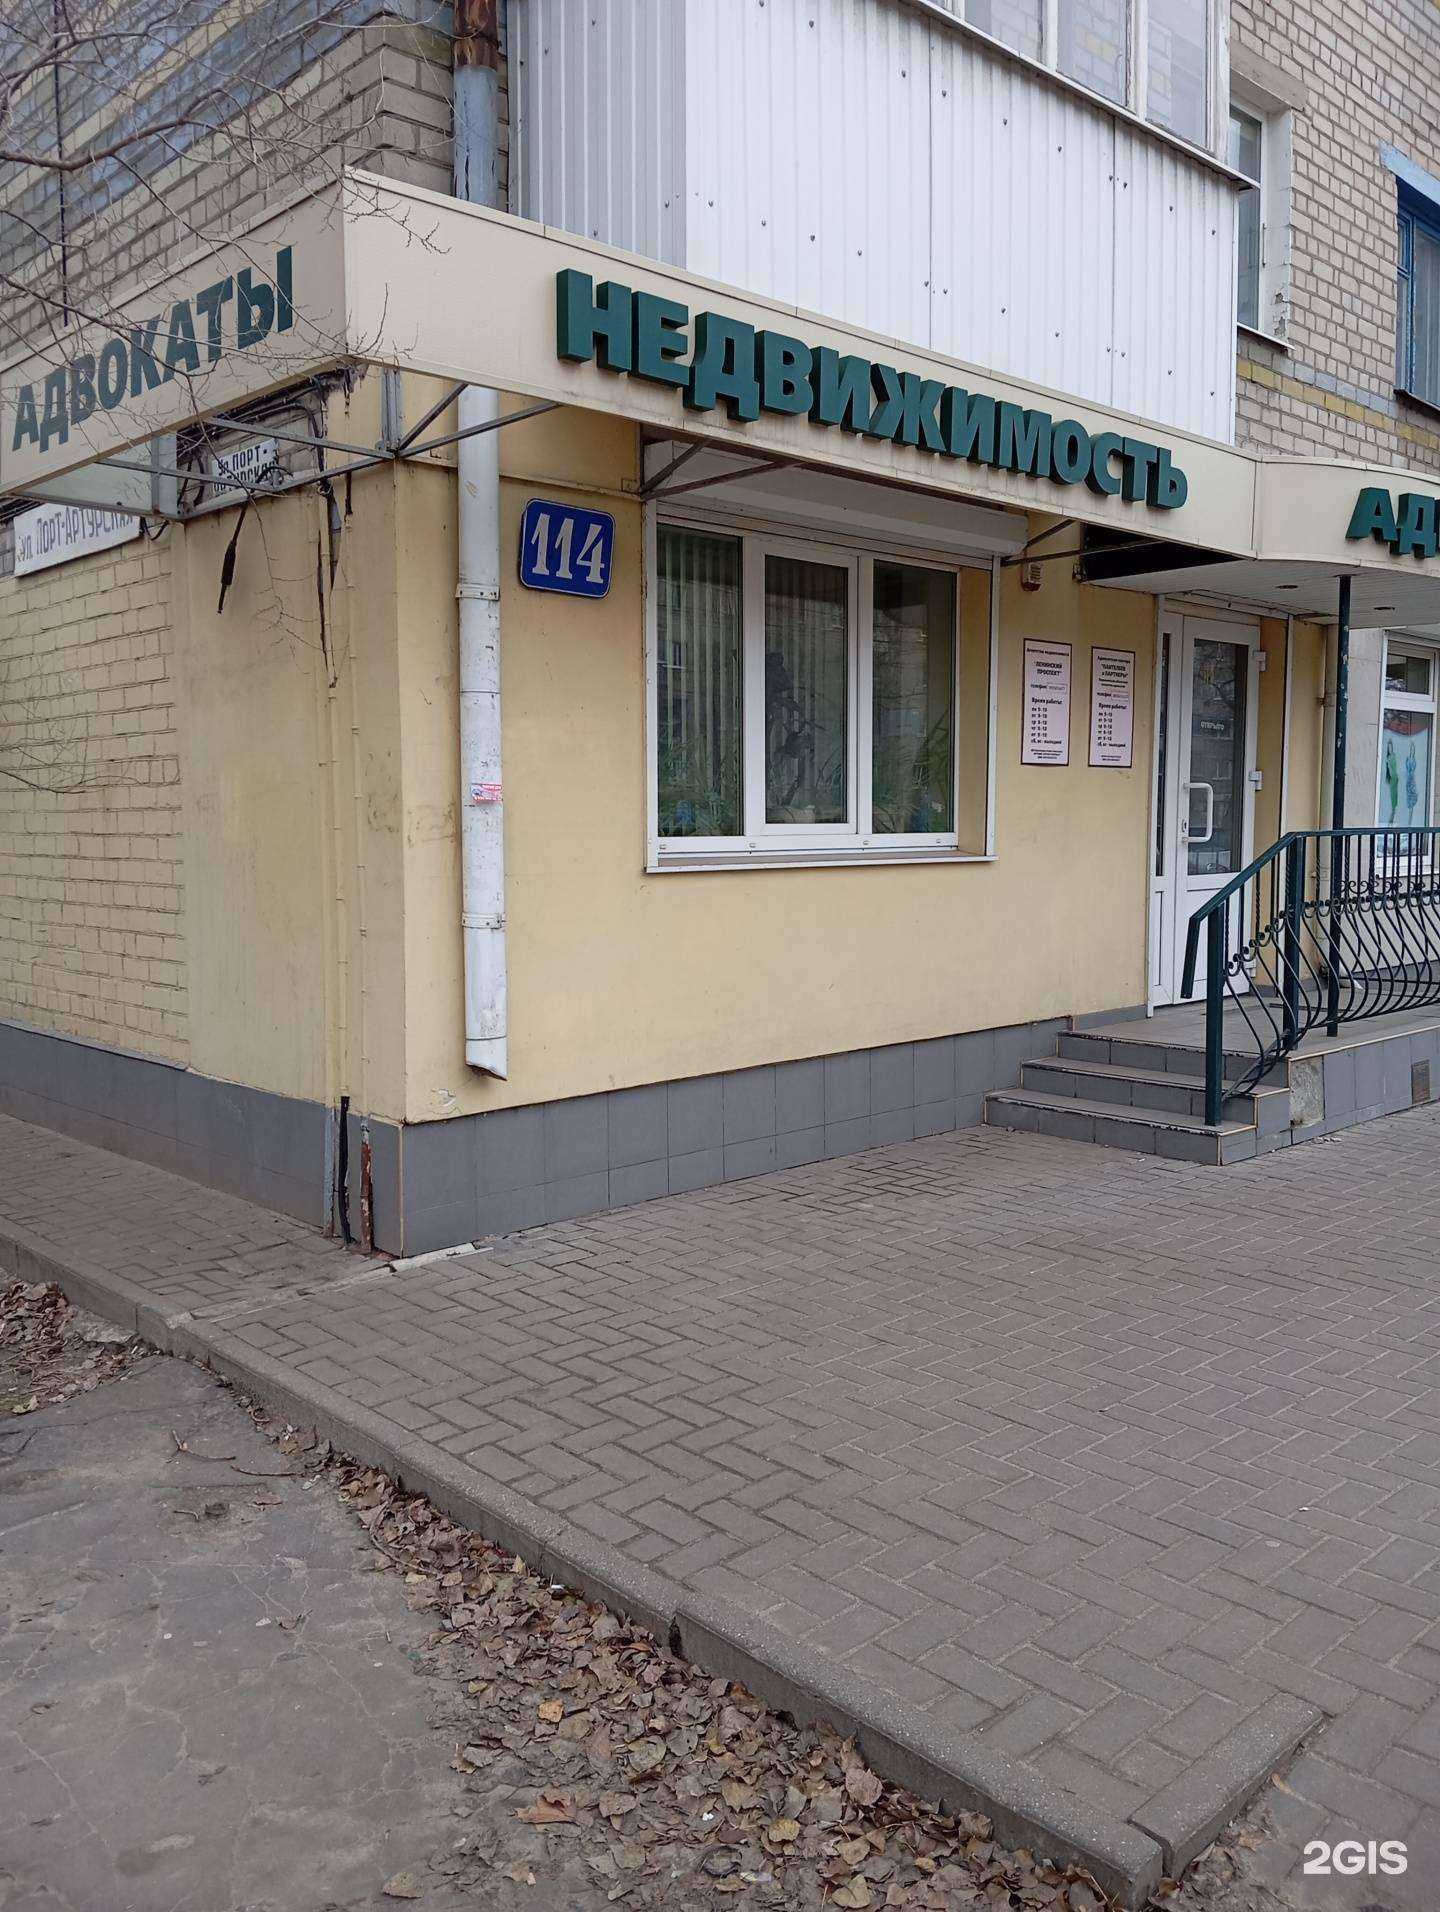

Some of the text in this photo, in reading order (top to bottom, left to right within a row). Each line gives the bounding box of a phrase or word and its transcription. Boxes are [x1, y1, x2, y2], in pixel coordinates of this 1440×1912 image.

[12, 245, 293, 453] АДВОКАТЫ
[557, 268, 1188, 510] НЕДВИЖИМОСТЬ
[531, 513, 605, 584] 114
[1345, 487, 1440, 559] АД
